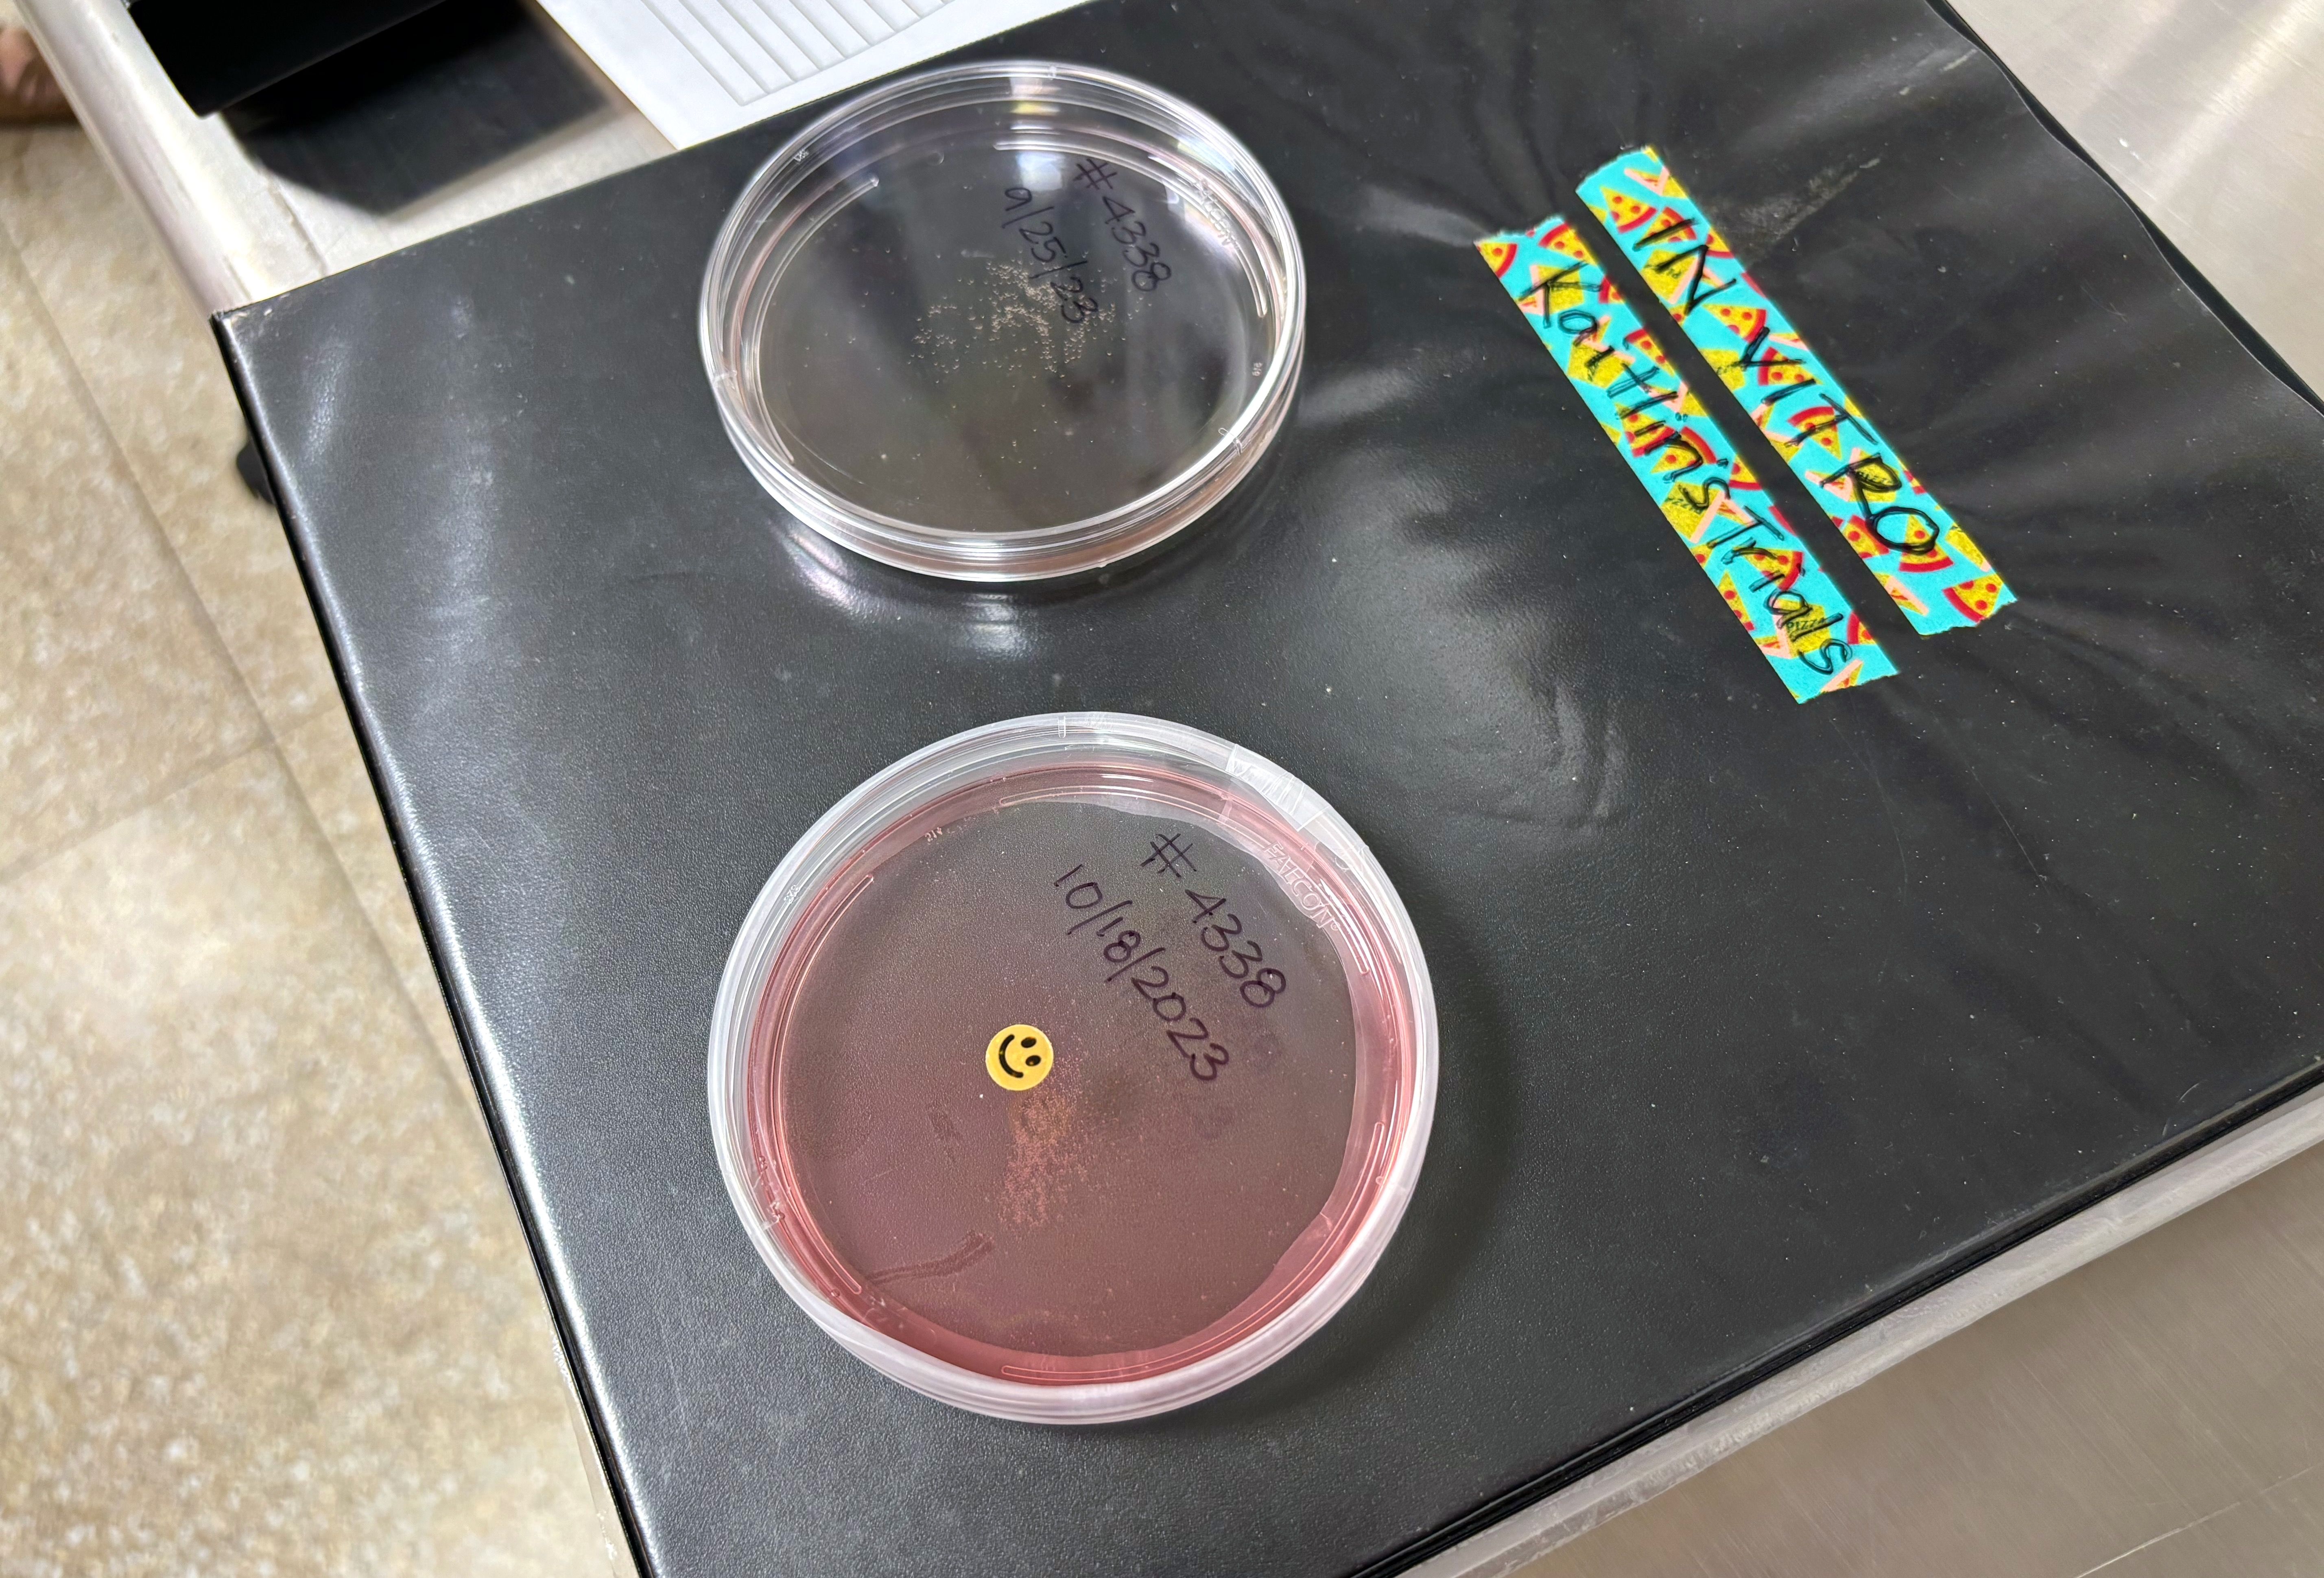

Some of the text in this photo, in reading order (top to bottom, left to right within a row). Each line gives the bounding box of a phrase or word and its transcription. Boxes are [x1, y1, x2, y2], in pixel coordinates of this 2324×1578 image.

[1001, 187, 1098, 324] 9/25/23
[1632, 218, 1940, 555] IN VITRO
[1054, 864, 1230, 1081] 10/18/2023
